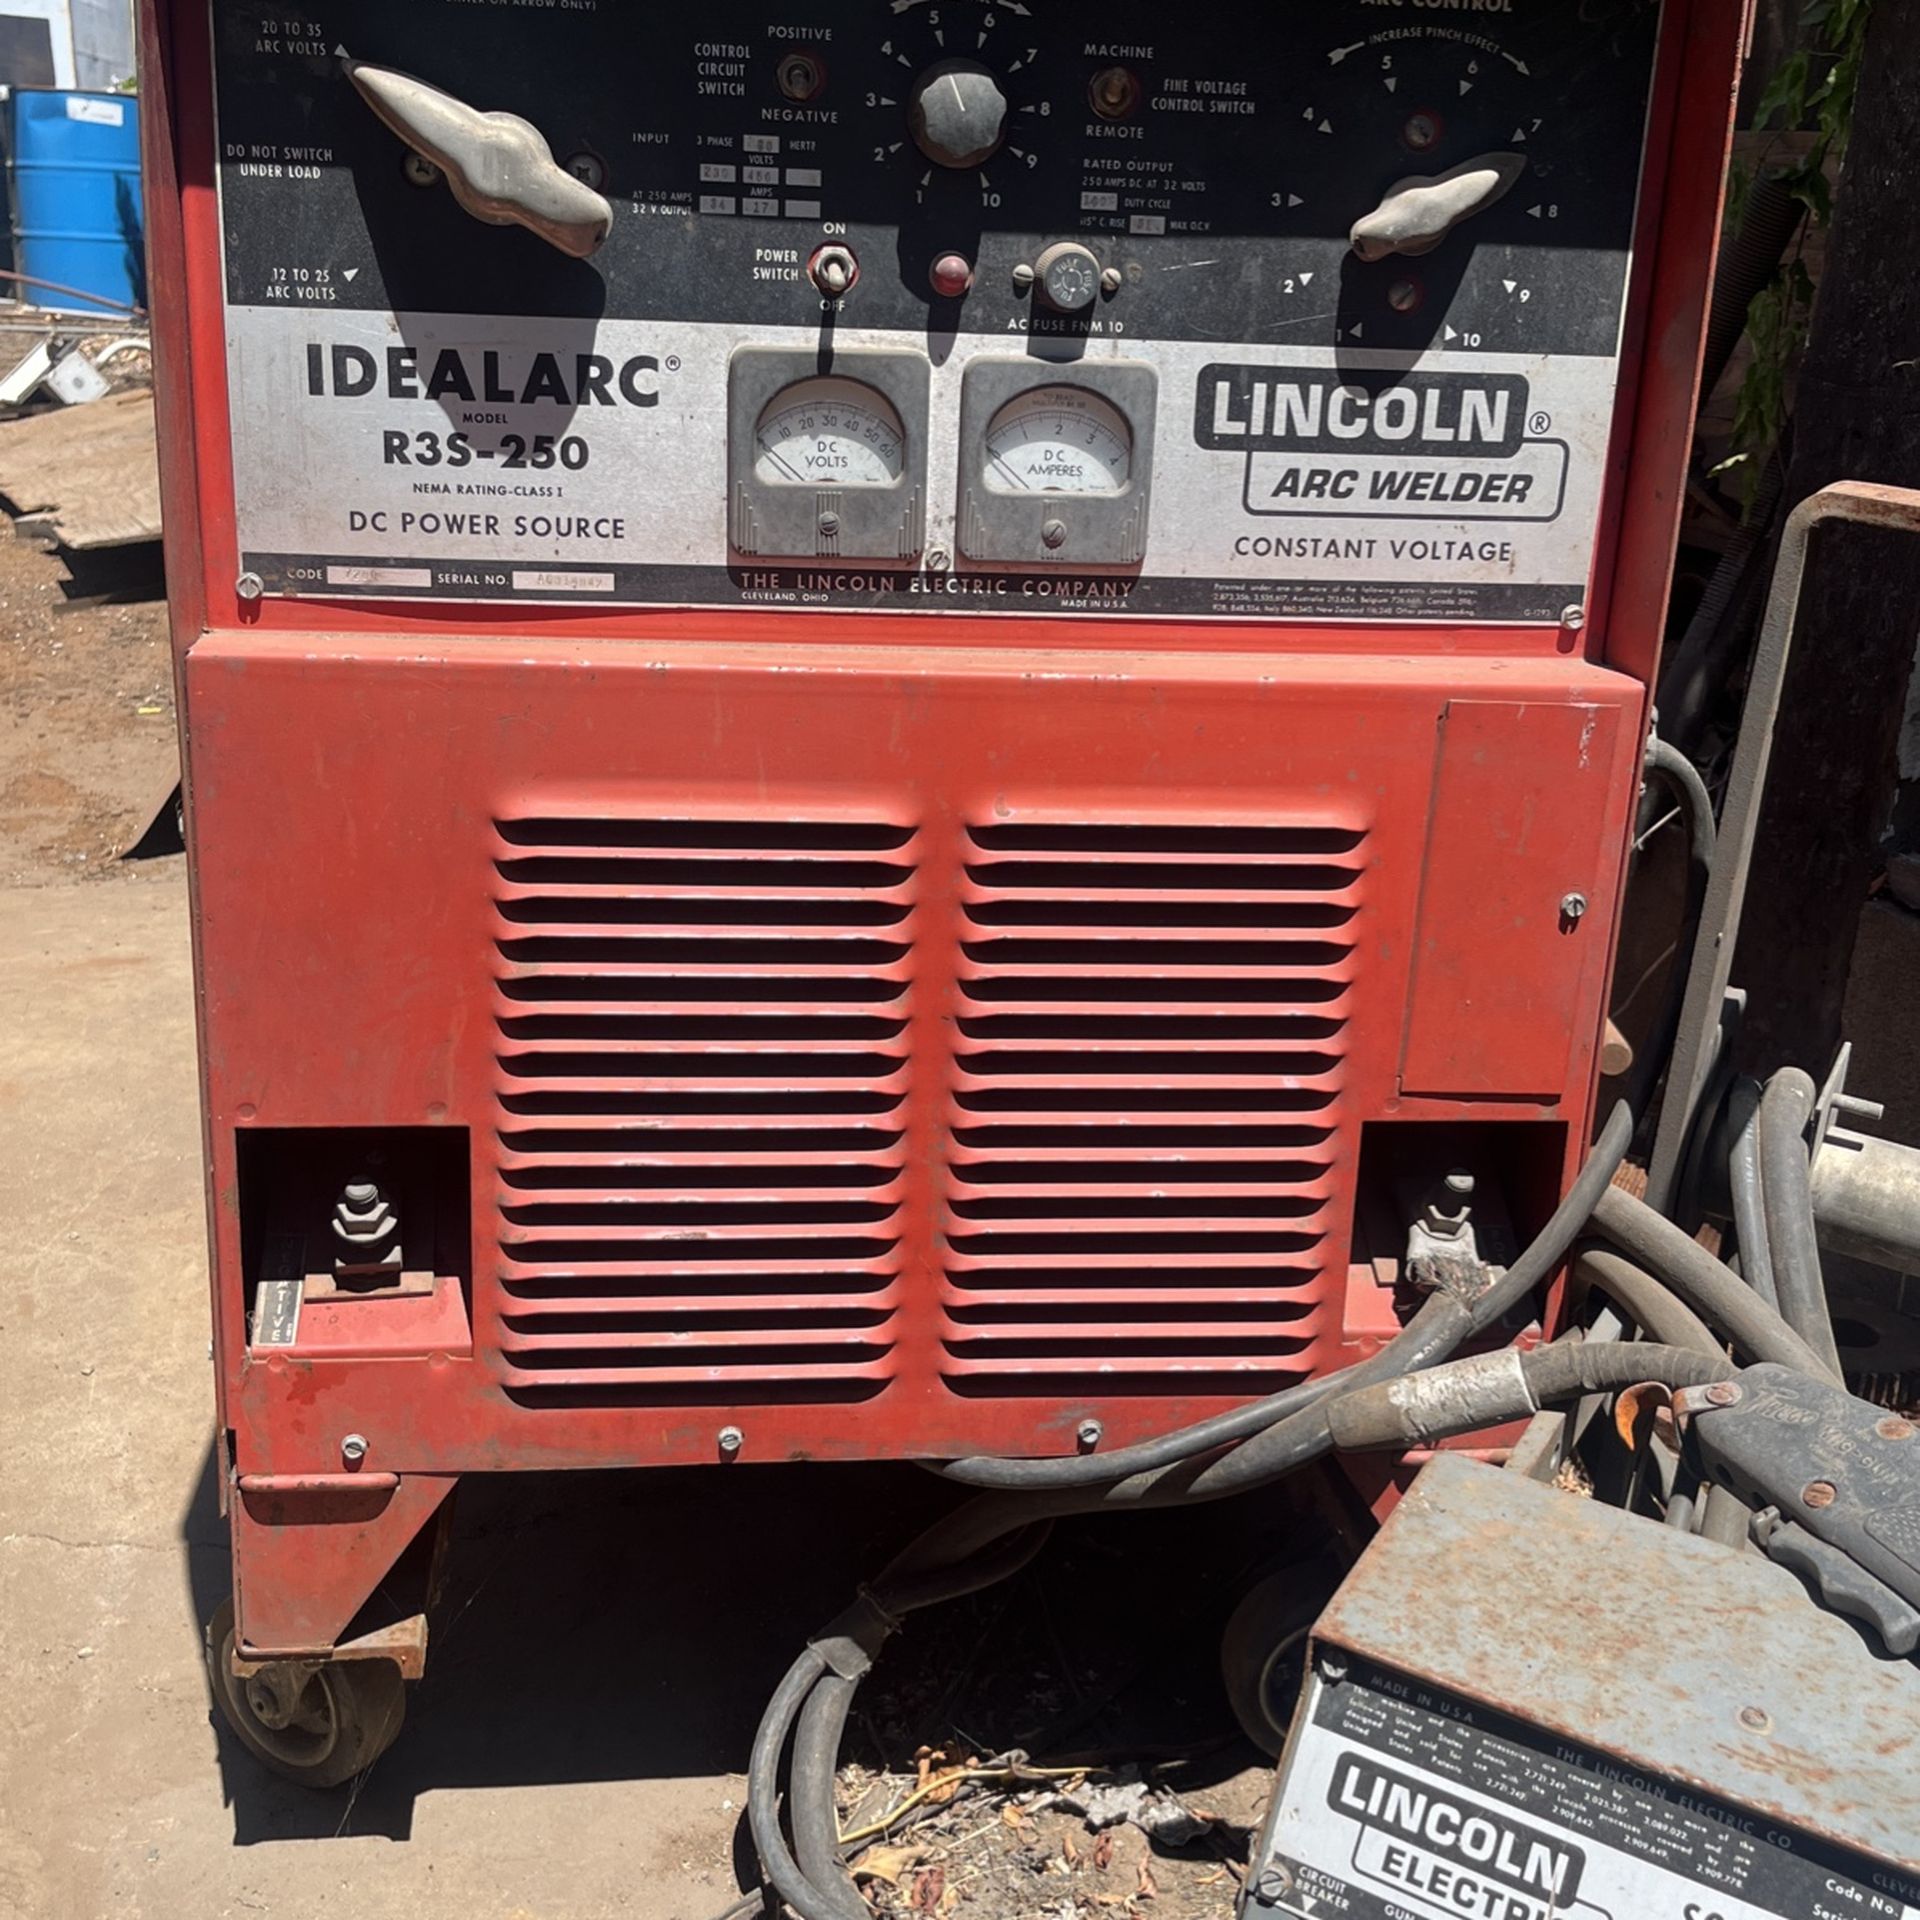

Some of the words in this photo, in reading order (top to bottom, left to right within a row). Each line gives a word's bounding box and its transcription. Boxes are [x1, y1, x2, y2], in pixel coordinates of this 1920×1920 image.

[930, 11, 939, 24] 5
[984, 14, 995, 28] 6
[261, 21, 278, 35] 20
[284, 22, 300, 36] TO
[306, 23, 322, 38] 35
[768, 26, 832, 41] POSITIVE
[1369, 26, 1423, 44] INCREASE
[1426, 26, 1462, 41] PINCH
[1463, 33, 1501, 54] EFFECT
[255, 40, 281, 55] ARC
[287, 42, 327, 57] VOLTS
[694, 43, 750, 59] CONTROL
[881, 42, 892, 55] 4
[1027, 49, 1038, 63] 7
[1084, 45, 1154, 60] MACHINE
[697, 62, 745, 77] CIRCUIT
[1381, 56, 1392, 70] 5
[1467, 61, 1478, 75] 6
[698, 81, 745, 96] SWITCH
[1164, 79, 1191, 93] FINE
[1195, 80, 1247, 96] VOLTAGE
[866, 93, 876, 107] 3
[1152, 97, 1205, 113] CONTROL
[1210, 100, 1256, 115] SWITCH
[761, 108, 839, 124] NEGATIVE
[1040, 103, 1051, 116] 8
[1303, 107, 1313, 121] 4
[1086, 125, 1145, 140] REMOTE
[1531, 118, 1542, 132] 7
[632, 132, 670, 145] INPUT
[707, 136, 733, 148] PHASE
[789, 140, 816, 152] HERTZ
[227, 144, 247, 158] DO
[251, 145, 277, 160] NOT
[283, 146, 334, 162] SWITCH
[748, 155, 774, 165] VOLTS
[875, 148, 885, 162] 2
[1027, 155, 1038, 168] 9
[1083, 158, 1121, 170] RATED
[1126, 160, 1174, 173] OUTPUT
[240, 164, 284, 178] UNDER
[288, 165, 321, 180] LOAD
[1082, 176, 1102, 187] 250
[1104, 177, 1127, 188] AMPS
[1146, 179, 1158, 189] AT
[1164, 179, 1177, 191] 32
[1181, 181, 1207, 192] VOLTS
[648, 191, 667, 201] 250
[670, 192, 692, 202] AMPS
[750, 187, 774, 198] AMPS
[917, 191, 922, 204] 1
[1272, 193, 1282, 207] 3
[753, 201, 770, 214] 17
[983, 194, 1001, 208] 10
[1124, 197, 1145, 208] DUTY
[1148, 198, 1171, 210] CYCLE
[632, 203, 645, 215] 32
[650, 204, 657, 215] V
[660, 205, 692, 217] OUTPUT
[1548, 205, 1558, 219] 8
[823, 223, 846, 235] ON
[756, 249, 798, 264] POWER
[272, 267, 286, 282] 12
[292, 268, 310, 283] TO
[315, 269, 331, 284] 25
[753, 267, 799, 281] SWITCH
[266, 285, 291, 299] ARC
[296, 286, 336, 301] VOLTS
[1284, 280, 1294, 294] 2
[1520, 289, 1530, 303] 9
[819, 299, 846, 313] OFF
[1007, 317, 1028, 331] AC
[1033, 318, 1066, 333] FUSE
[1071, 319, 1104, 333] FNM
[1109, 320, 1124, 334] 10
[1463, 333, 1481, 347] 10
[462, 412, 508, 425] MODEL
[1212, 380, 1510, 443] LINCOLN
[779, 426, 791, 440] 10
[799, 417, 815, 431] 20
[822, 415, 838, 427] 30
[844, 419, 860, 432] 40
[864, 428, 880, 444] 50
[879, 443, 895, 459] 60
[1055, 424, 1063, 435] 2
[1085, 433, 1096, 445] 3
[383, 430, 590, 470] R3S-250
[805, 456, 849, 469] VOLTS
[1027, 463, 1083, 477] AMPERES
[412, 482, 452, 496] NEMA
[457, 484, 553, 499] RATING-CLASS
[1271, 467, 1359, 500] ARC
[1369, 469, 1535, 504] WELDER
[349, 511, 388, 534] DC
[401, 513, 501, 537] POWER
[514, 516, 626, 540] SOURCE
[1234, 536, 1378, 560] CONSTANT
[1390, 539, 1512, 562] VOLTAGE
[286, 567, 323, 582] CODE
[437, 573, 480, 586] SERIAL
[484, 574, 510, 588] NO.
[741, 572, 780, 588] THE
[797, 573, 896, 593] LINCOLN
[910, 577, 1008, 595] ELECTRIC
[1022, 579, 1133, 598] COMPANY
[741, 591, 798, 602] CLEVELAND,
[802, 593, 829, 602] OHIO
[1061, 599, 1088, 608] MADE
[1090, 600, 1100, 608] IN
[1370, 1675, 1409, 1699] MADE
[1416, 1692, 1433, 1707] IN
[1395, 1716, 1423, 1733] United
[1556, 1746, 1586, 1767] THE
[1594, 1761, 1669, 1801] LINCOLN
[1679, 1796, 1756, 1835] ELECTRIC
[1567, 1773, 1602, 1791] covered
[1612, 1789, 1623, 1801] by
[1635, 1801, 1653, 1812] one
[1684, 1820, 1708, 1833] more
[1338, 1764, 1570, 1896] LINCOLN
[1298, 1865, 1348, 1896] CIRCUIT
[1294, 1878, 1351, 1912] BREAKER
[1825, 1878, 1864, 1903] Code
[1870, 1895, 1899, 1918] No.
[1384, 1903, 1416, 1920] GUN
